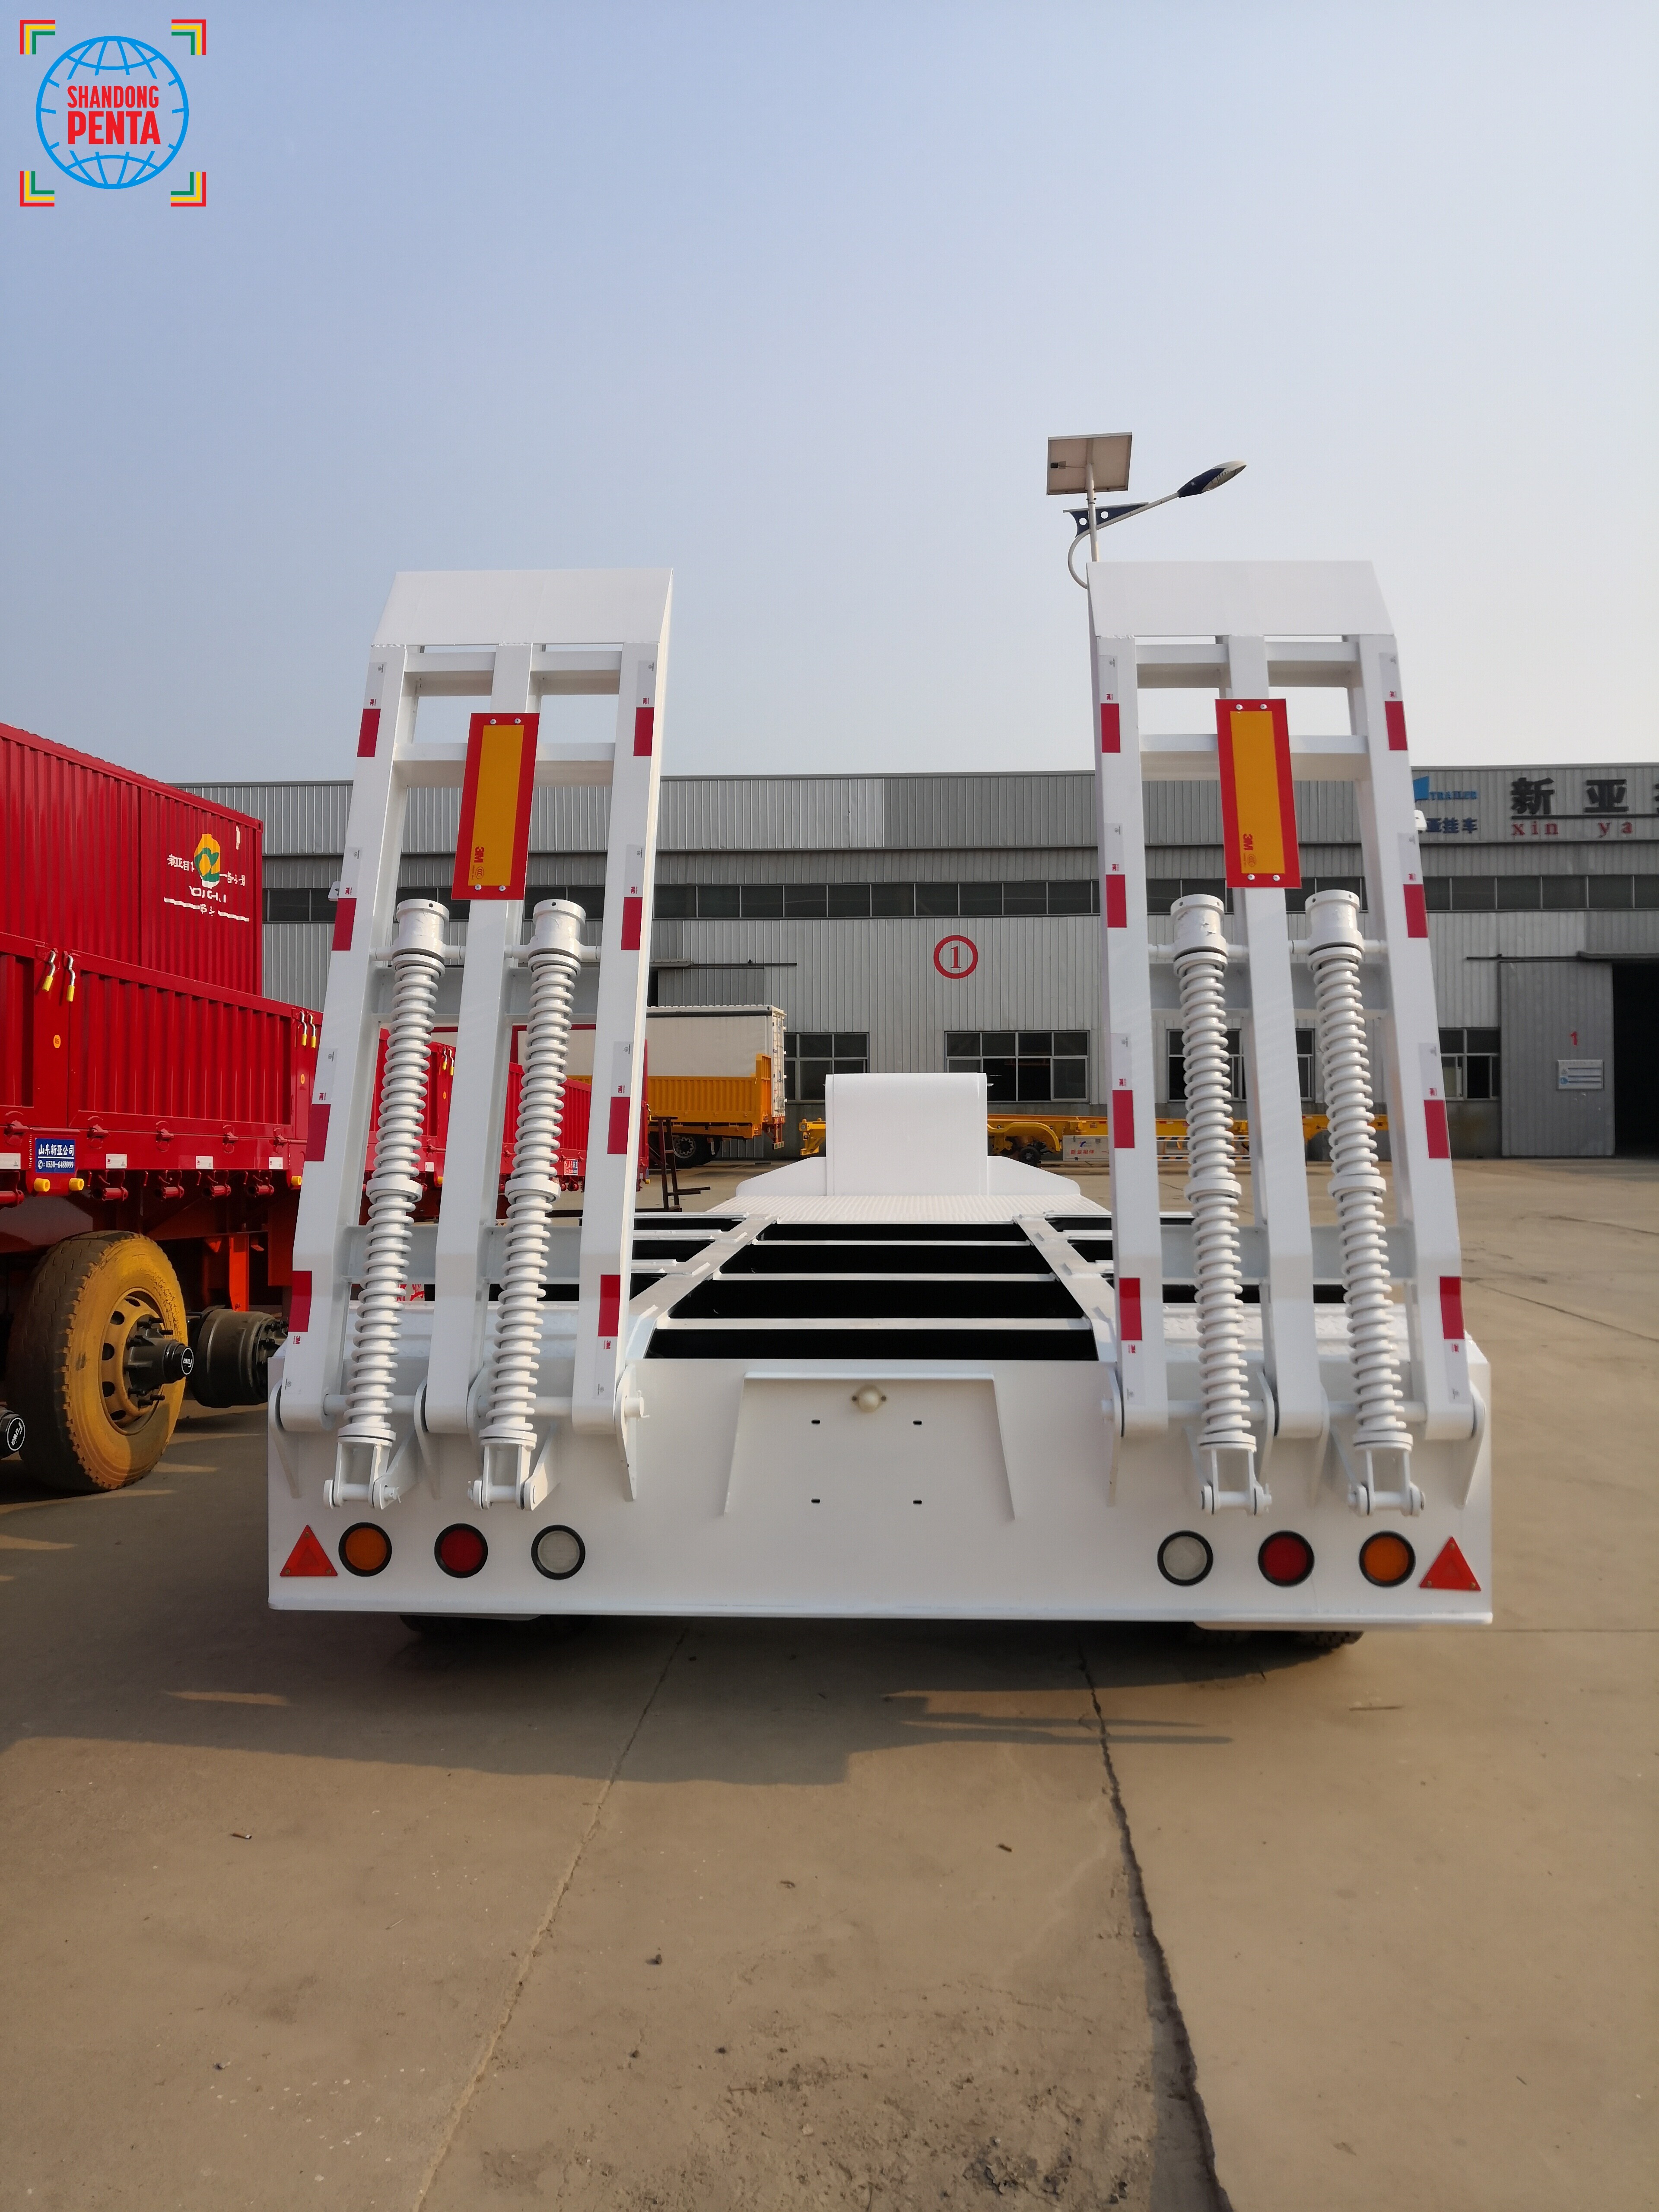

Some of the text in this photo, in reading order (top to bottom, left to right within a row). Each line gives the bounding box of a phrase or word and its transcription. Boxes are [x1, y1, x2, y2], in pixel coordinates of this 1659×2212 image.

[1430, 791, 1477, 800] TRAILER
[1511, 821, 1633, 838] xin ya
[1243, 833, 1253, 850] 3M
[474, 846, 484, 863] 3M
[950, 946, 961, 968] 1
[1570, 1032, 1577, 1045] 1
[38, 1144, 74, 1156] 山东新亚公司
